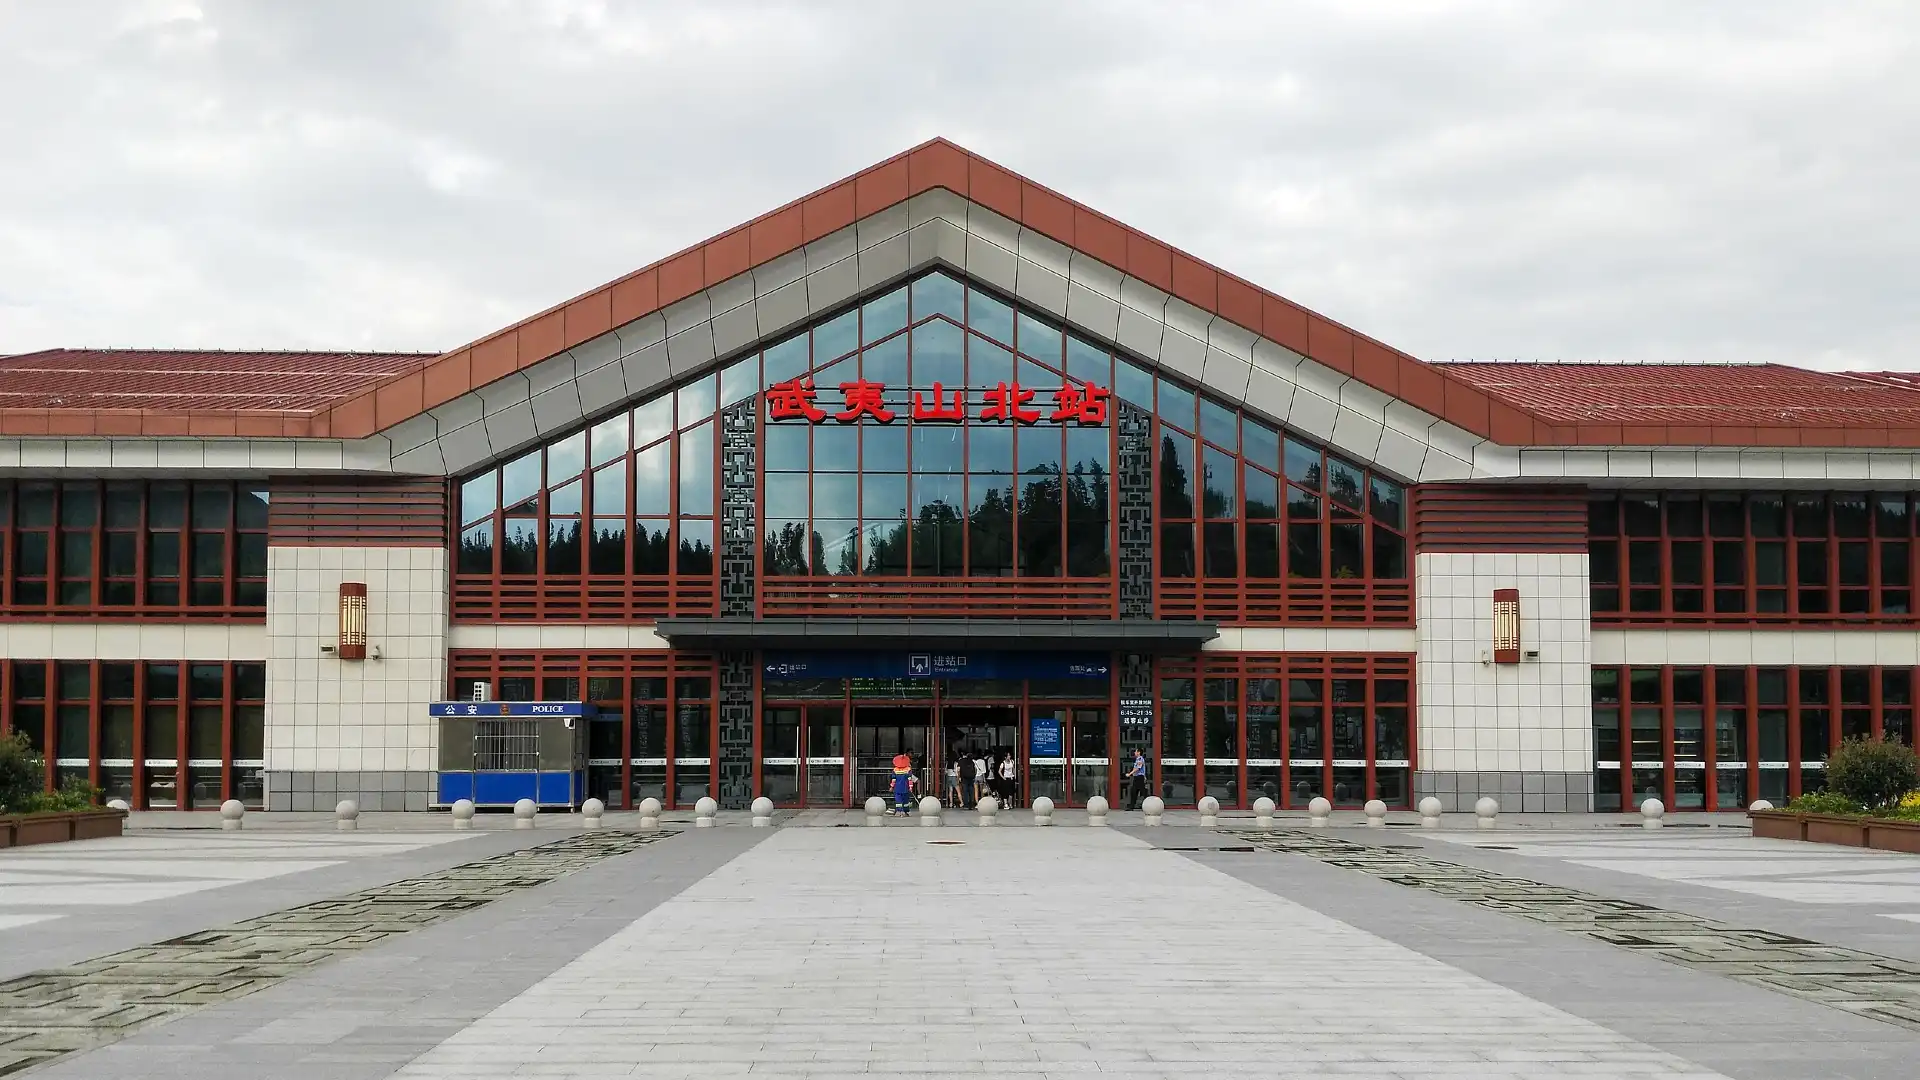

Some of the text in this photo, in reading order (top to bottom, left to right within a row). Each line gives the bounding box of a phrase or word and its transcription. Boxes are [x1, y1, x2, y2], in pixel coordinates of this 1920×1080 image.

[766, 378, 1110, 425] 武夷山北站
[933, 655, 967, 667] 进站口
[445, 704, 478, 715] 公安
[532, 705, 564, 713] POLICE
